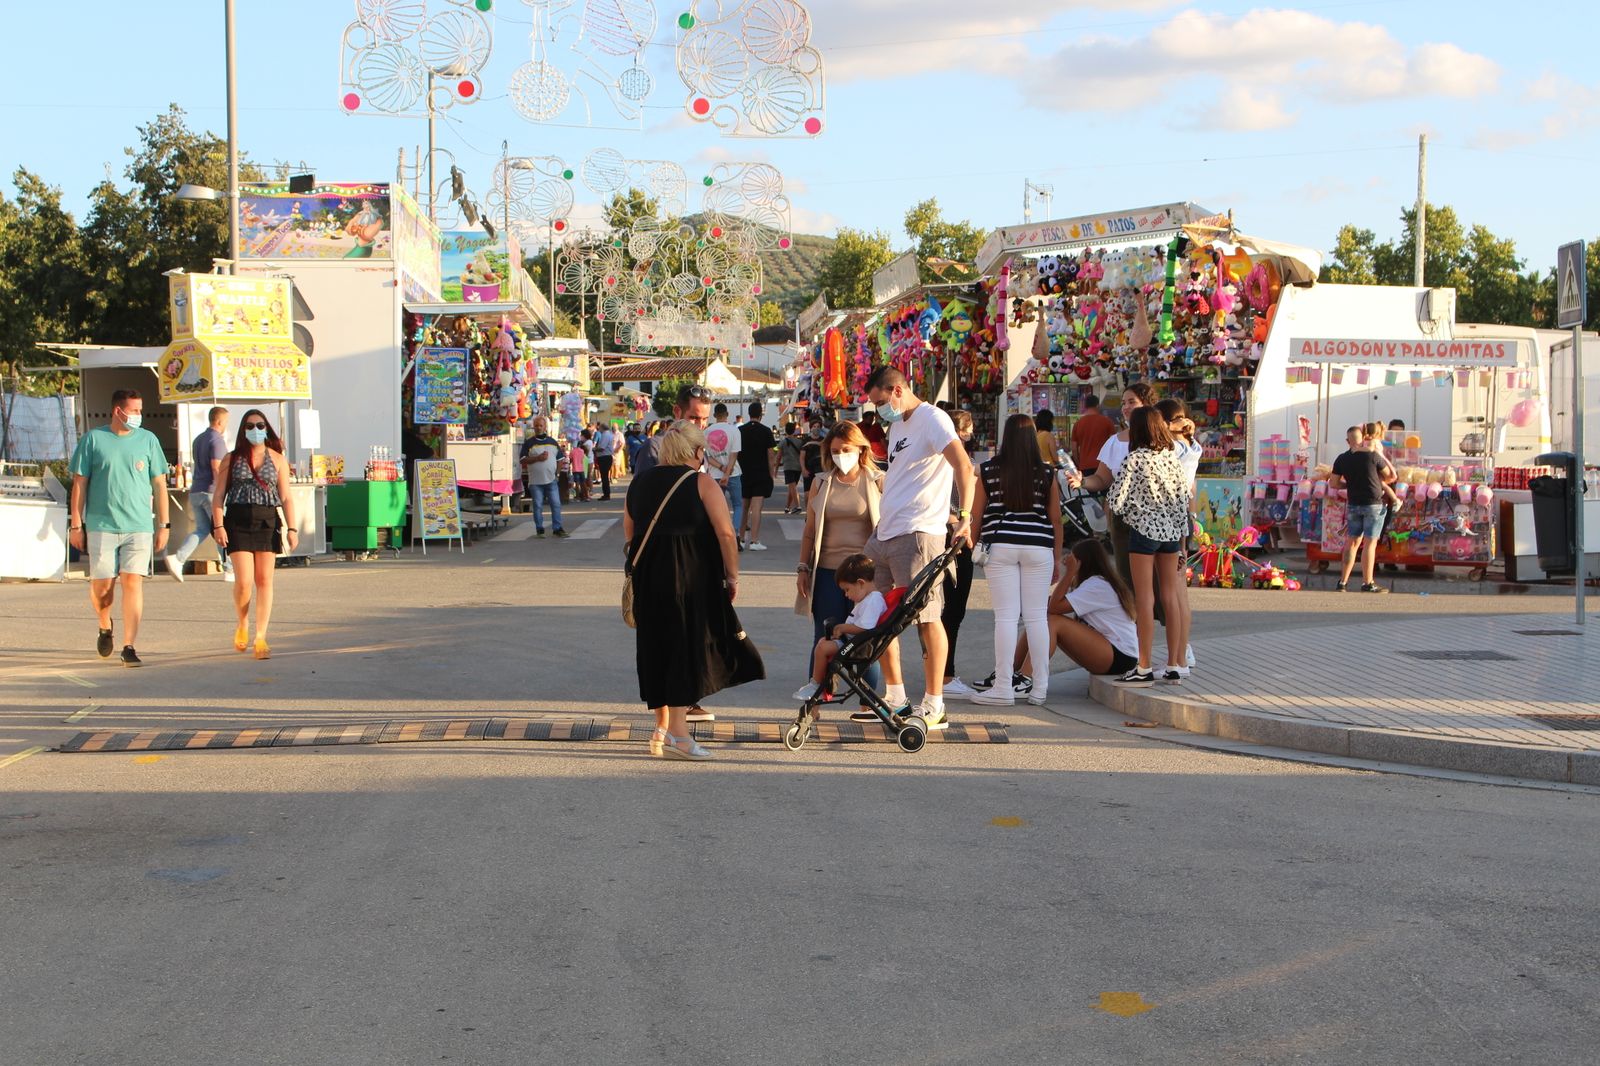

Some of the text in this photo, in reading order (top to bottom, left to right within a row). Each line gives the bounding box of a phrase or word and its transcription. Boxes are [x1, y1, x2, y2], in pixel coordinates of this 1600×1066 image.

[1041, 226, 1068, 243] PESCA
[1081, 222, 1094, 237] DE
[1107, 216, 1136, 233] PATOS
[1401, 342, 1505, 359] PALOMITAS
